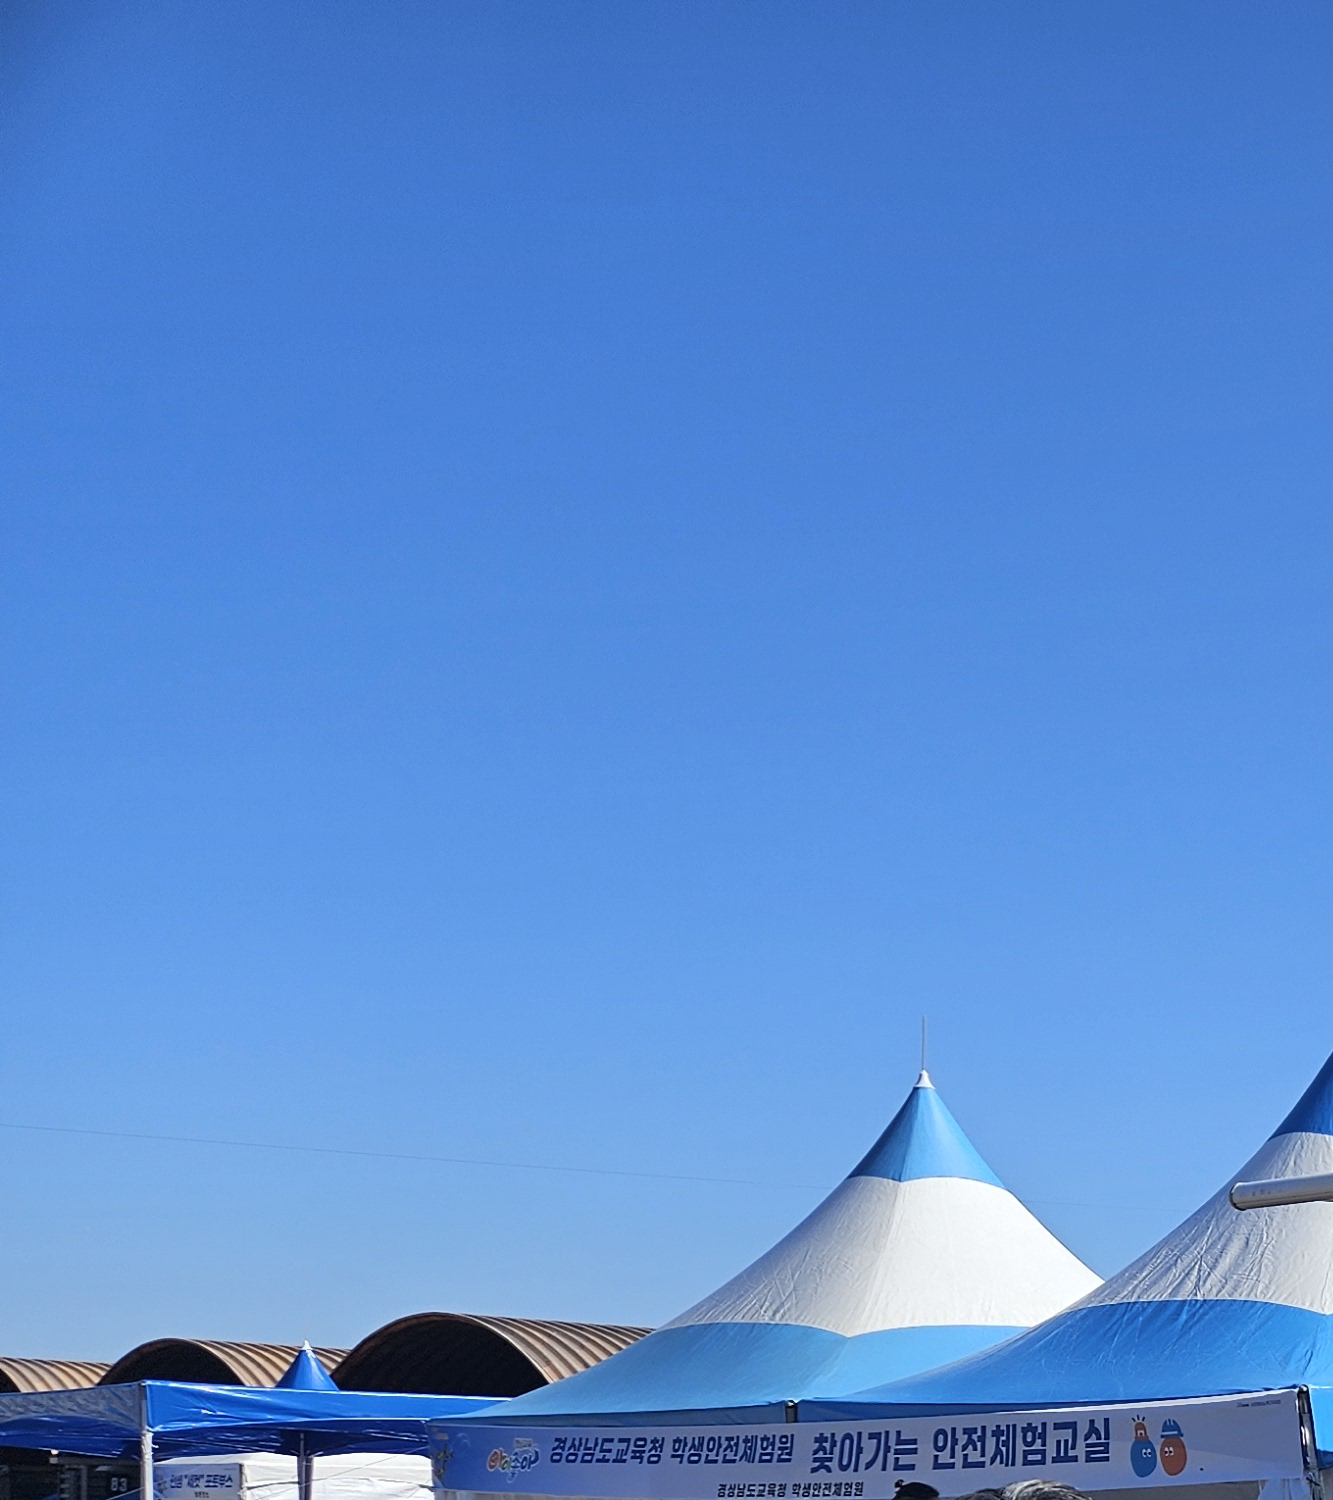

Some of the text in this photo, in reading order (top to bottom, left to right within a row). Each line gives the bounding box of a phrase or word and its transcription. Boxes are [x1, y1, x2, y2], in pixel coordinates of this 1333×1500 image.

[549, 1417, 1112, 1475] 경상남도교육청 학생안전체험원 찾아가는 안전체험교실
[111, 1477, 128, 1492] 83
[717, 1480, 864, 1499] 경상남도교육청 학생안전체험원
